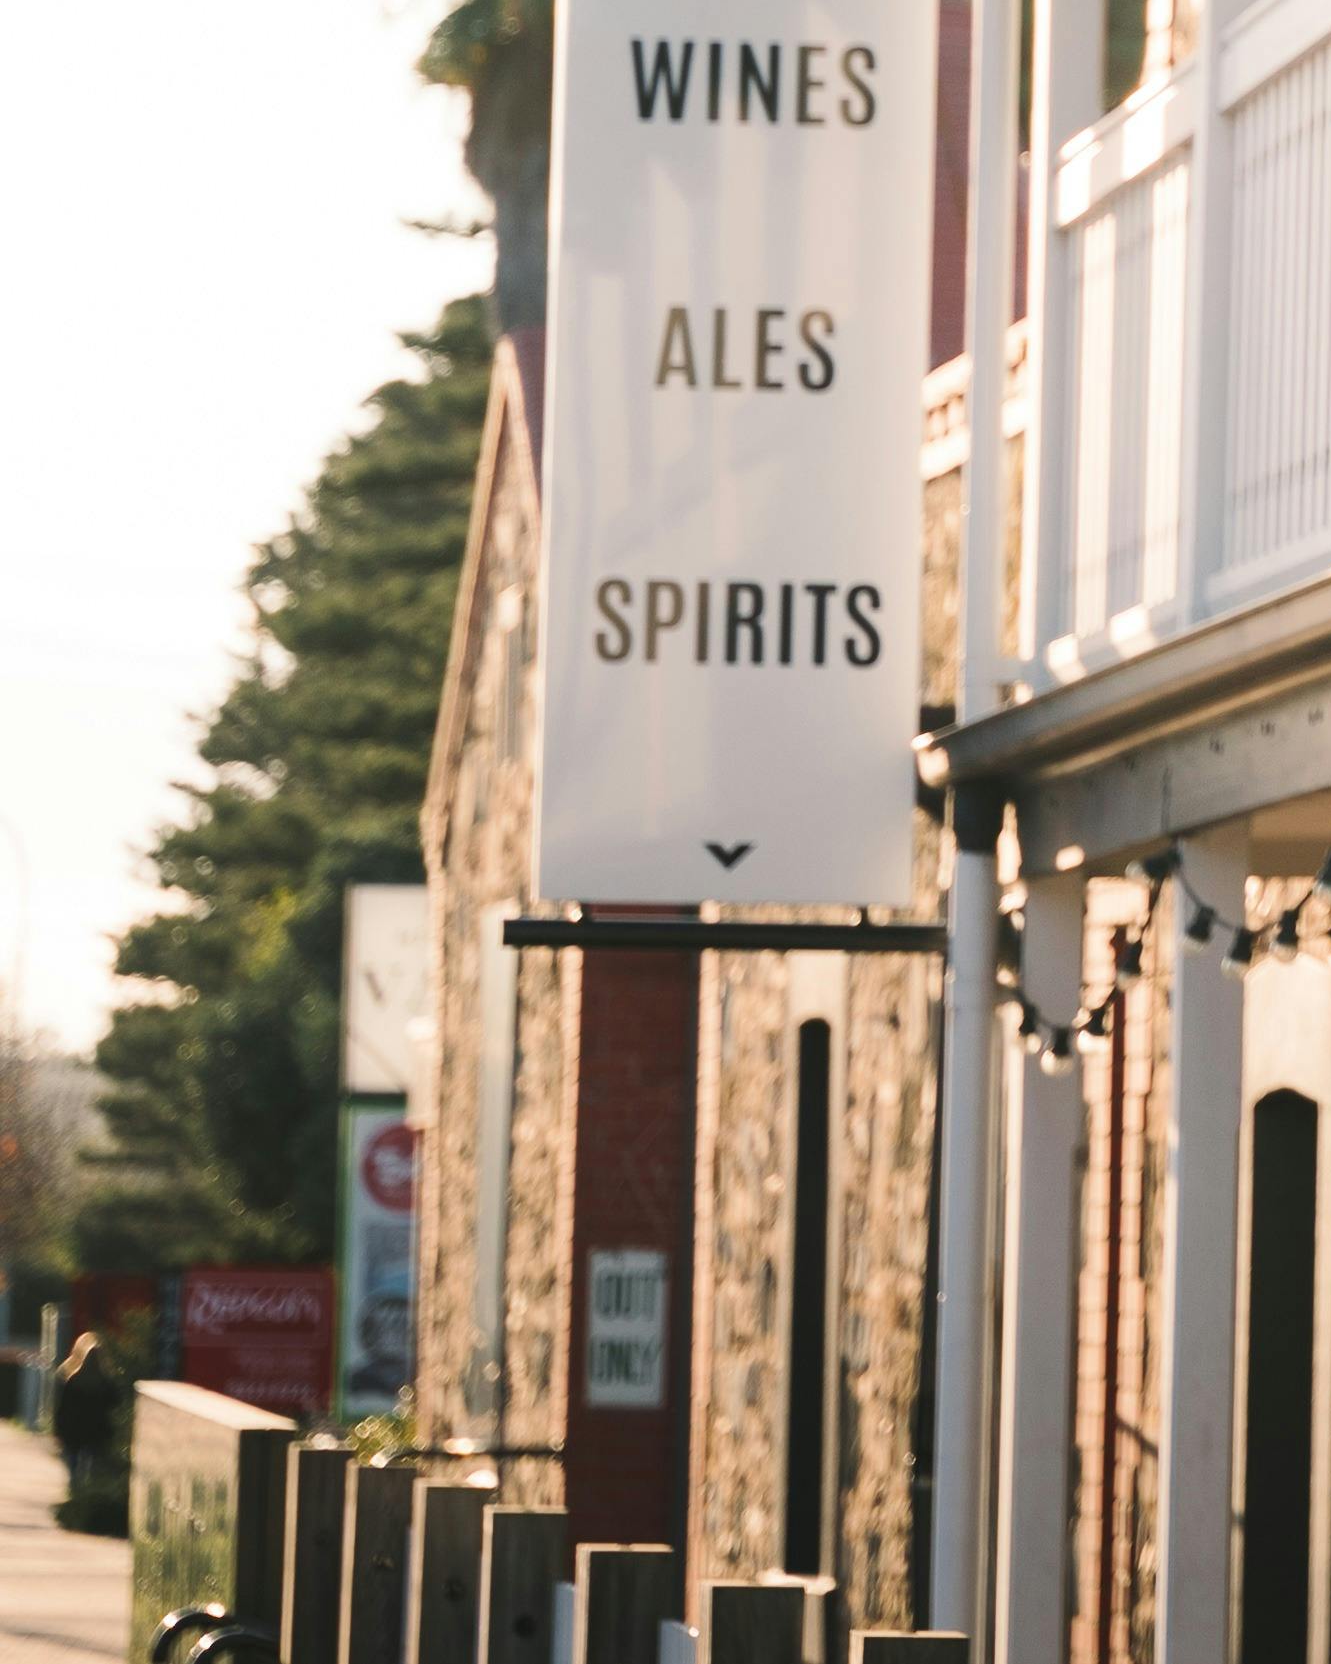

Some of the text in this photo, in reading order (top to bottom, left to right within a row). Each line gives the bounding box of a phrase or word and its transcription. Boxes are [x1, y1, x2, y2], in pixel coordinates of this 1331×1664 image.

[630, 37, 877, 127] WINES
[654, 306, 837, 395] ALES
[594, 577, 883, 670] SPIRITS
